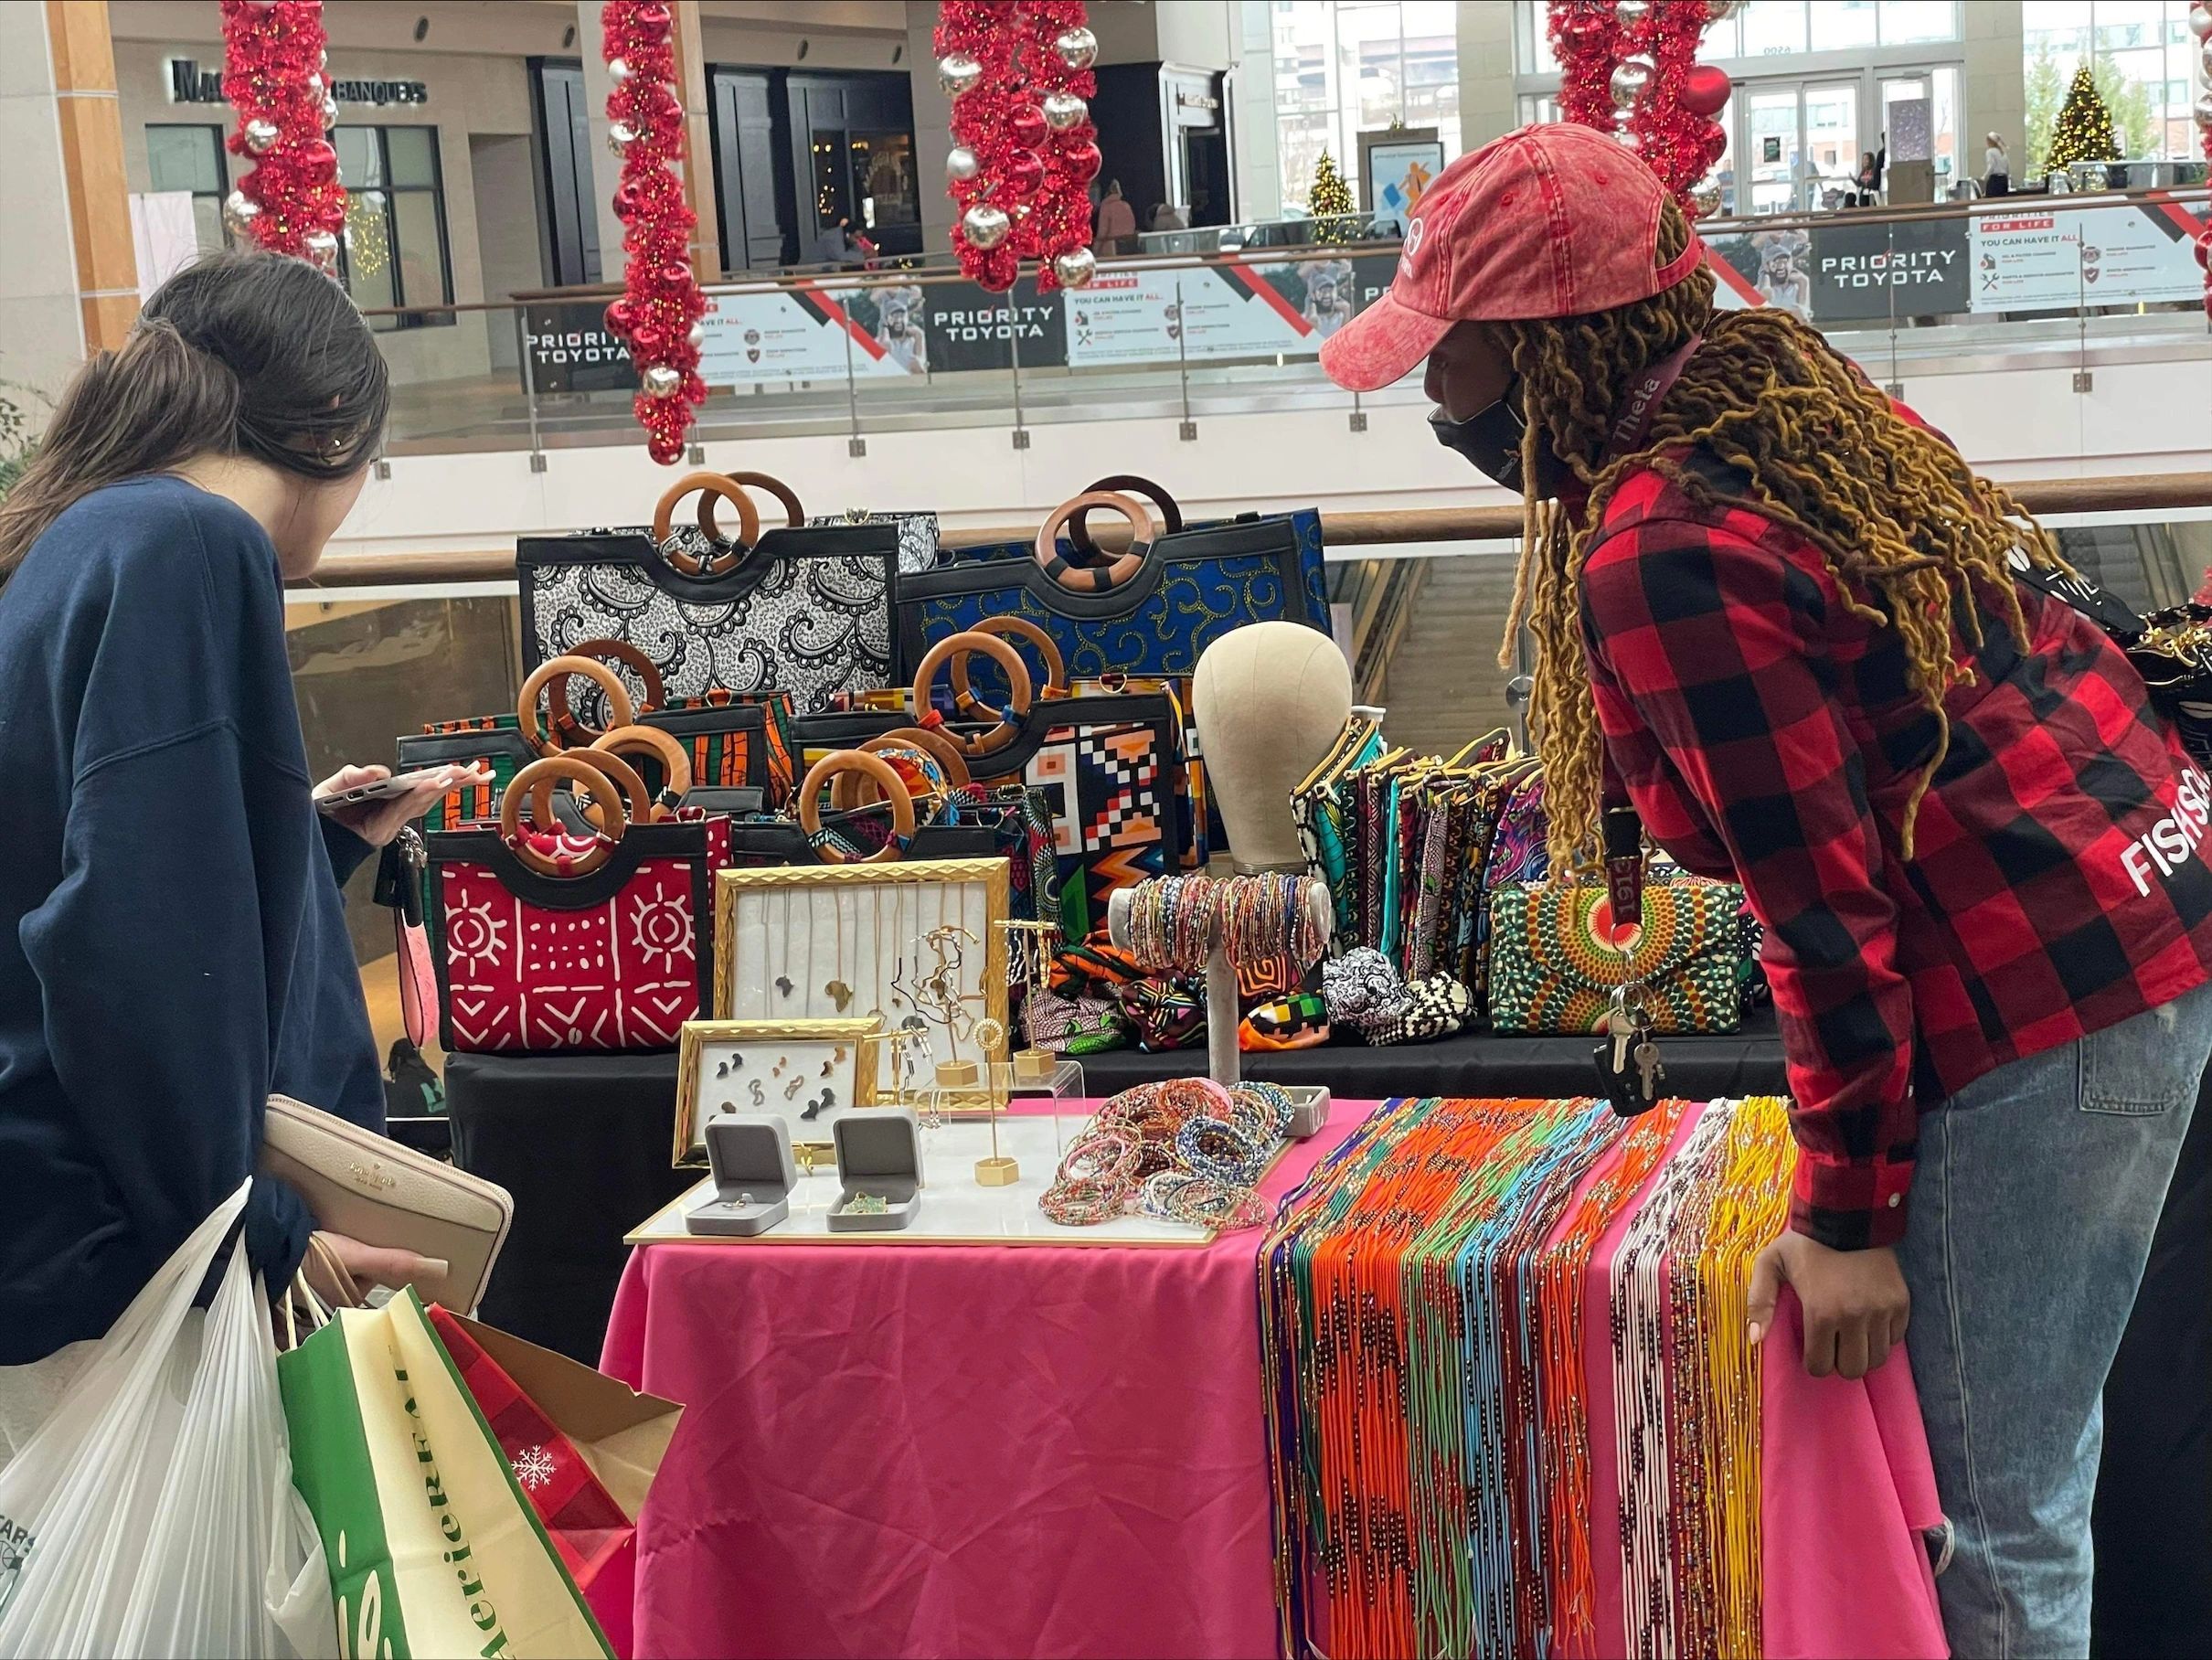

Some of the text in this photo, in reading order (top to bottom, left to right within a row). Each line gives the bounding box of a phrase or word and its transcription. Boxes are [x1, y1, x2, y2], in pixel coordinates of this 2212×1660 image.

[1982, 219, 2050, 230] FOR LIFE
[2002, 238, 2022, 246] CAN
[2024, 236, 2049, 245] HAVE
[1822, 250, 1956, 272] PRIORITY
[1834, 269, 1944, 288] TOYOTA
[1074, 297, 1091, 305] YOU
[1092, 296, 1111, 304] CAN
[1112, 295, 1135, 303] HAVE
[697, 318, 716, 326] AVE
[934, 305, 1053, 327] PRIORITY
[526, 331, 621, 347] PRIORI
[946, 324, 1044, 343] TOYOTA
[537, 347, 631, 365] TOYOTA
[1612, 378, 1661, 441] Theta
